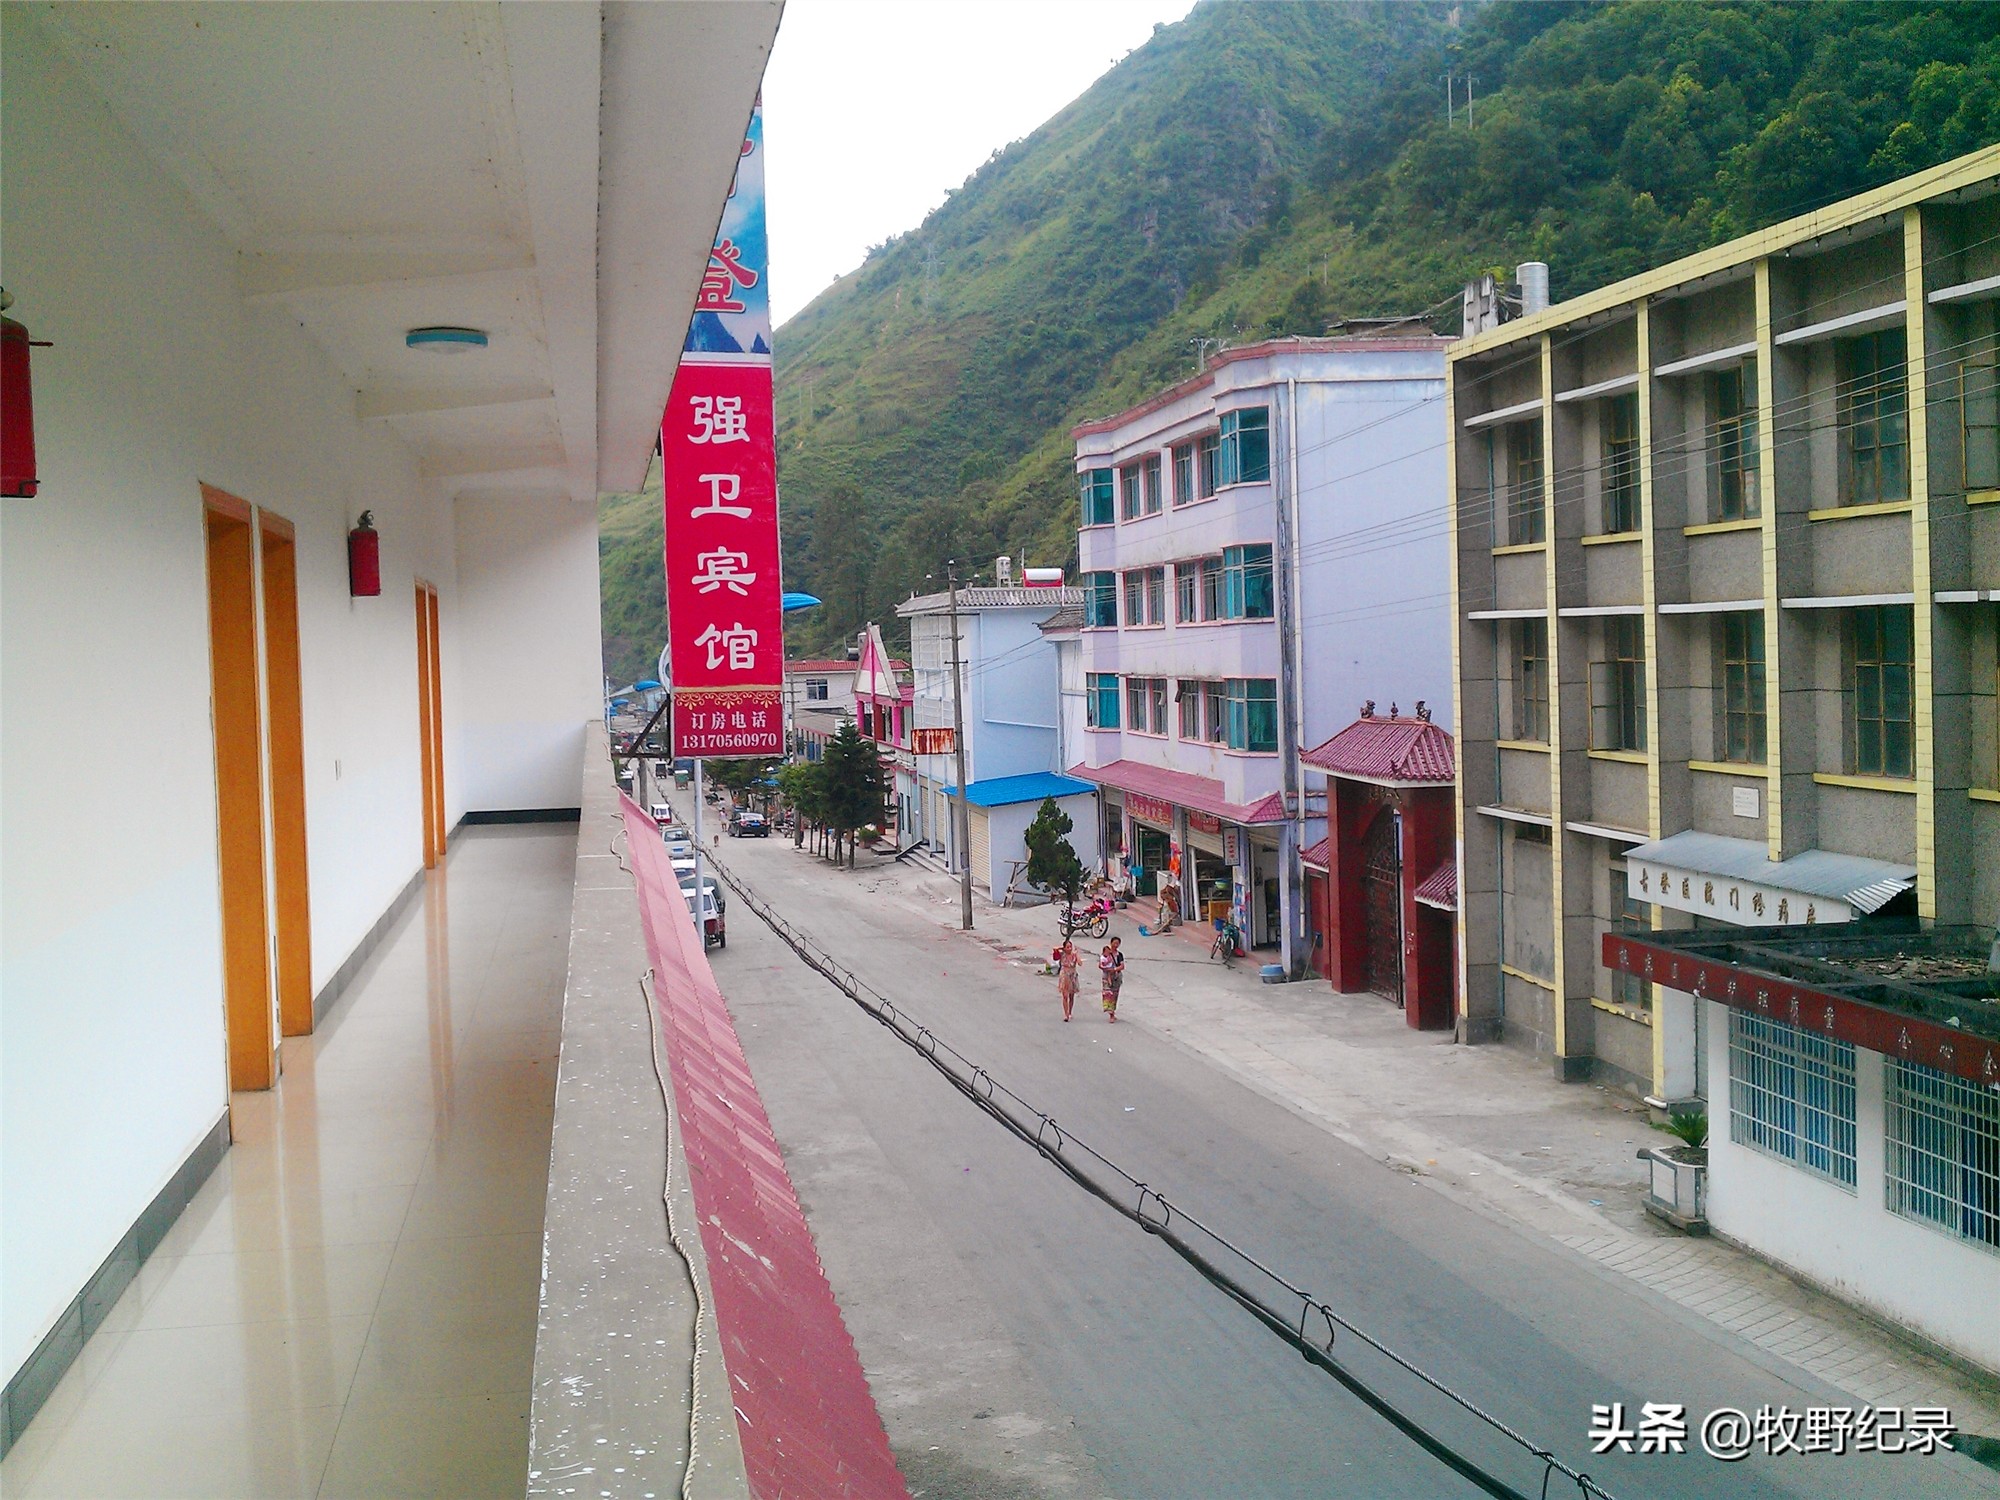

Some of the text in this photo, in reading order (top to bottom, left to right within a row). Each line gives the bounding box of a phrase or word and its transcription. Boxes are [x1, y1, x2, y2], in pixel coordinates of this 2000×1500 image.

[686, 394, 758, 671] 强卫宾馆
[691, 710, 767, 730] 订房电话
[682, 732, 777, 749] 13170560970
